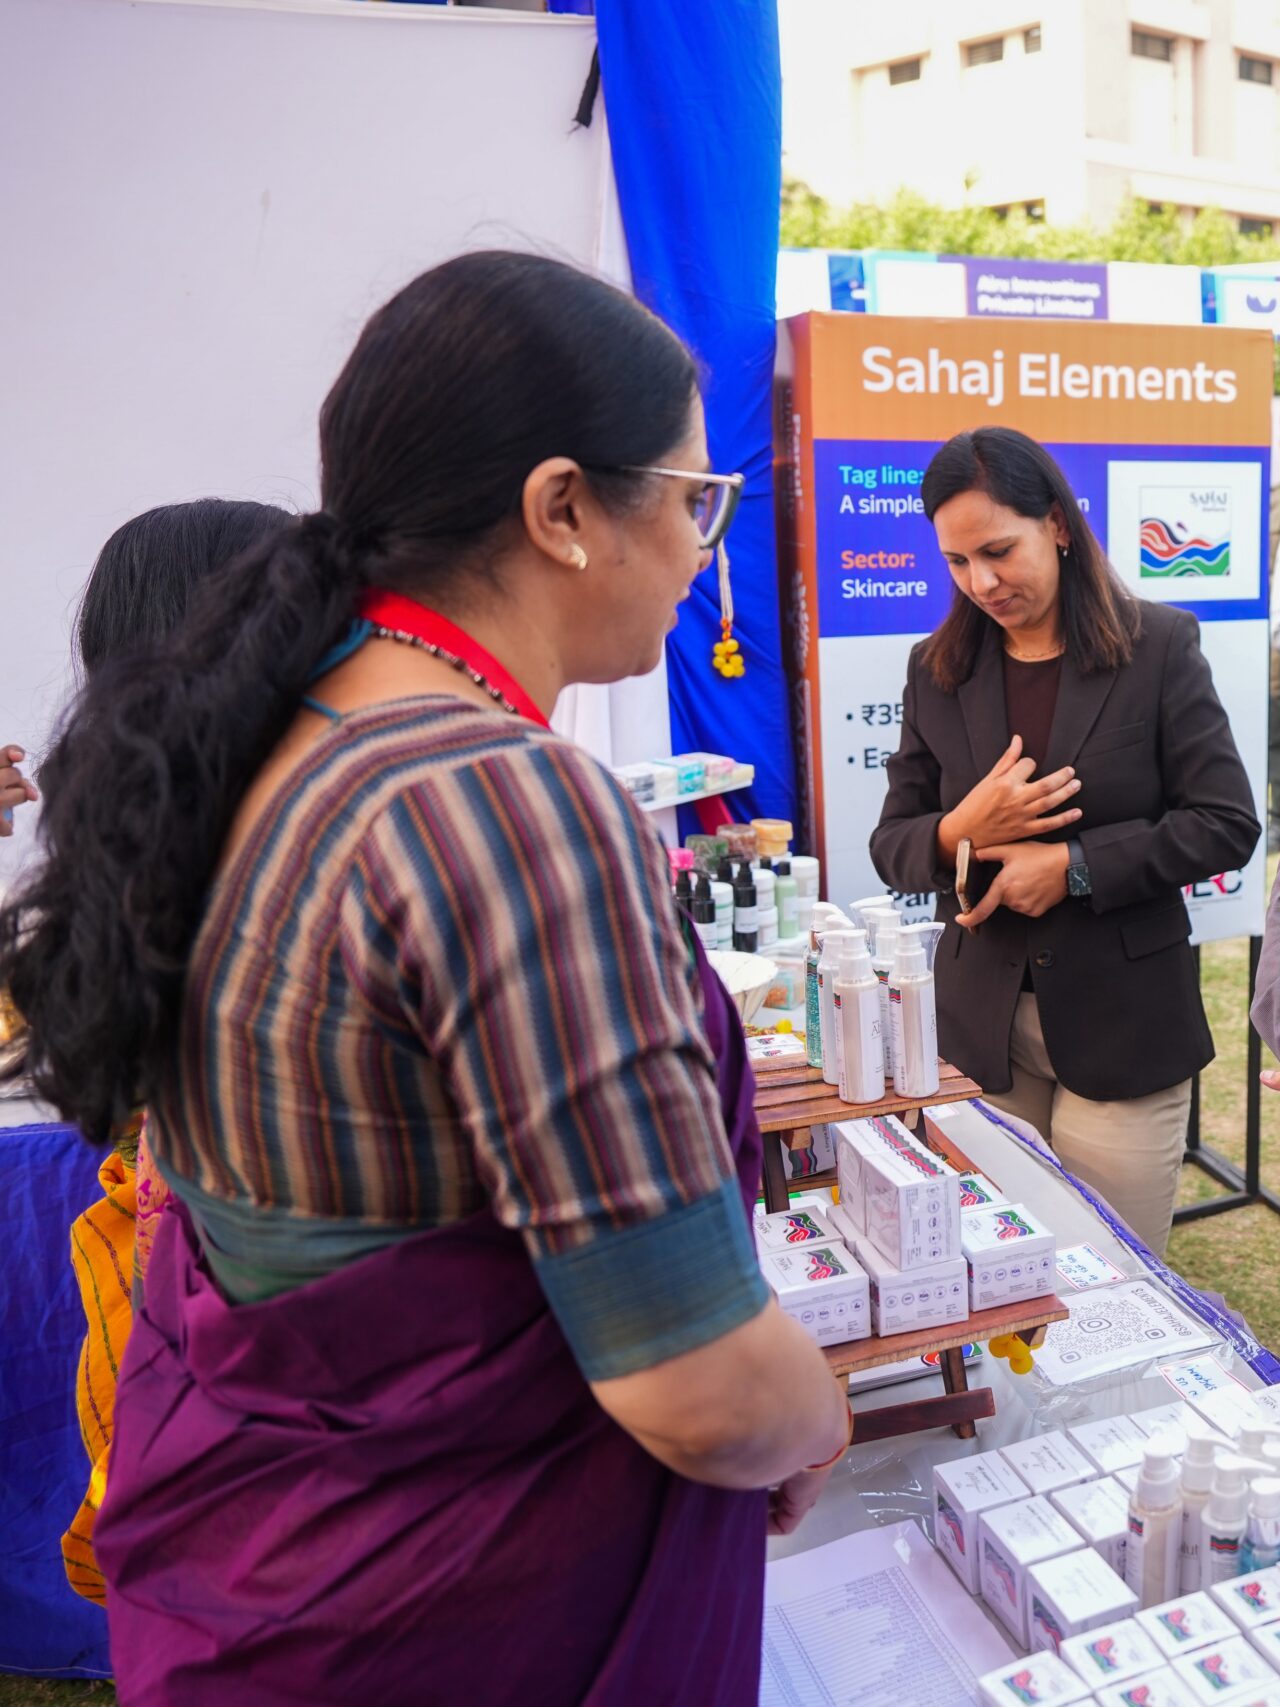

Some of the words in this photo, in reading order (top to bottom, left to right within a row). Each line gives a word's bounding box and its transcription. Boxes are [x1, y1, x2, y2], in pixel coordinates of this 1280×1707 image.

[977, 294, 1034, 315] Private
[1036, 297, 1094, 316] Limited
[862, 346, 1003, 406] Sahaj
[1018, 353, 1238, 404] Elements
[840, 466, 877, 489] Tag
[881, 466, 924, 484] line:
[840, 495, 855, 514] A
[859, 494, 924, 517] simple
[841, 551, 915, 569] Sector:
[841, 579, 928, 598] Skincare
